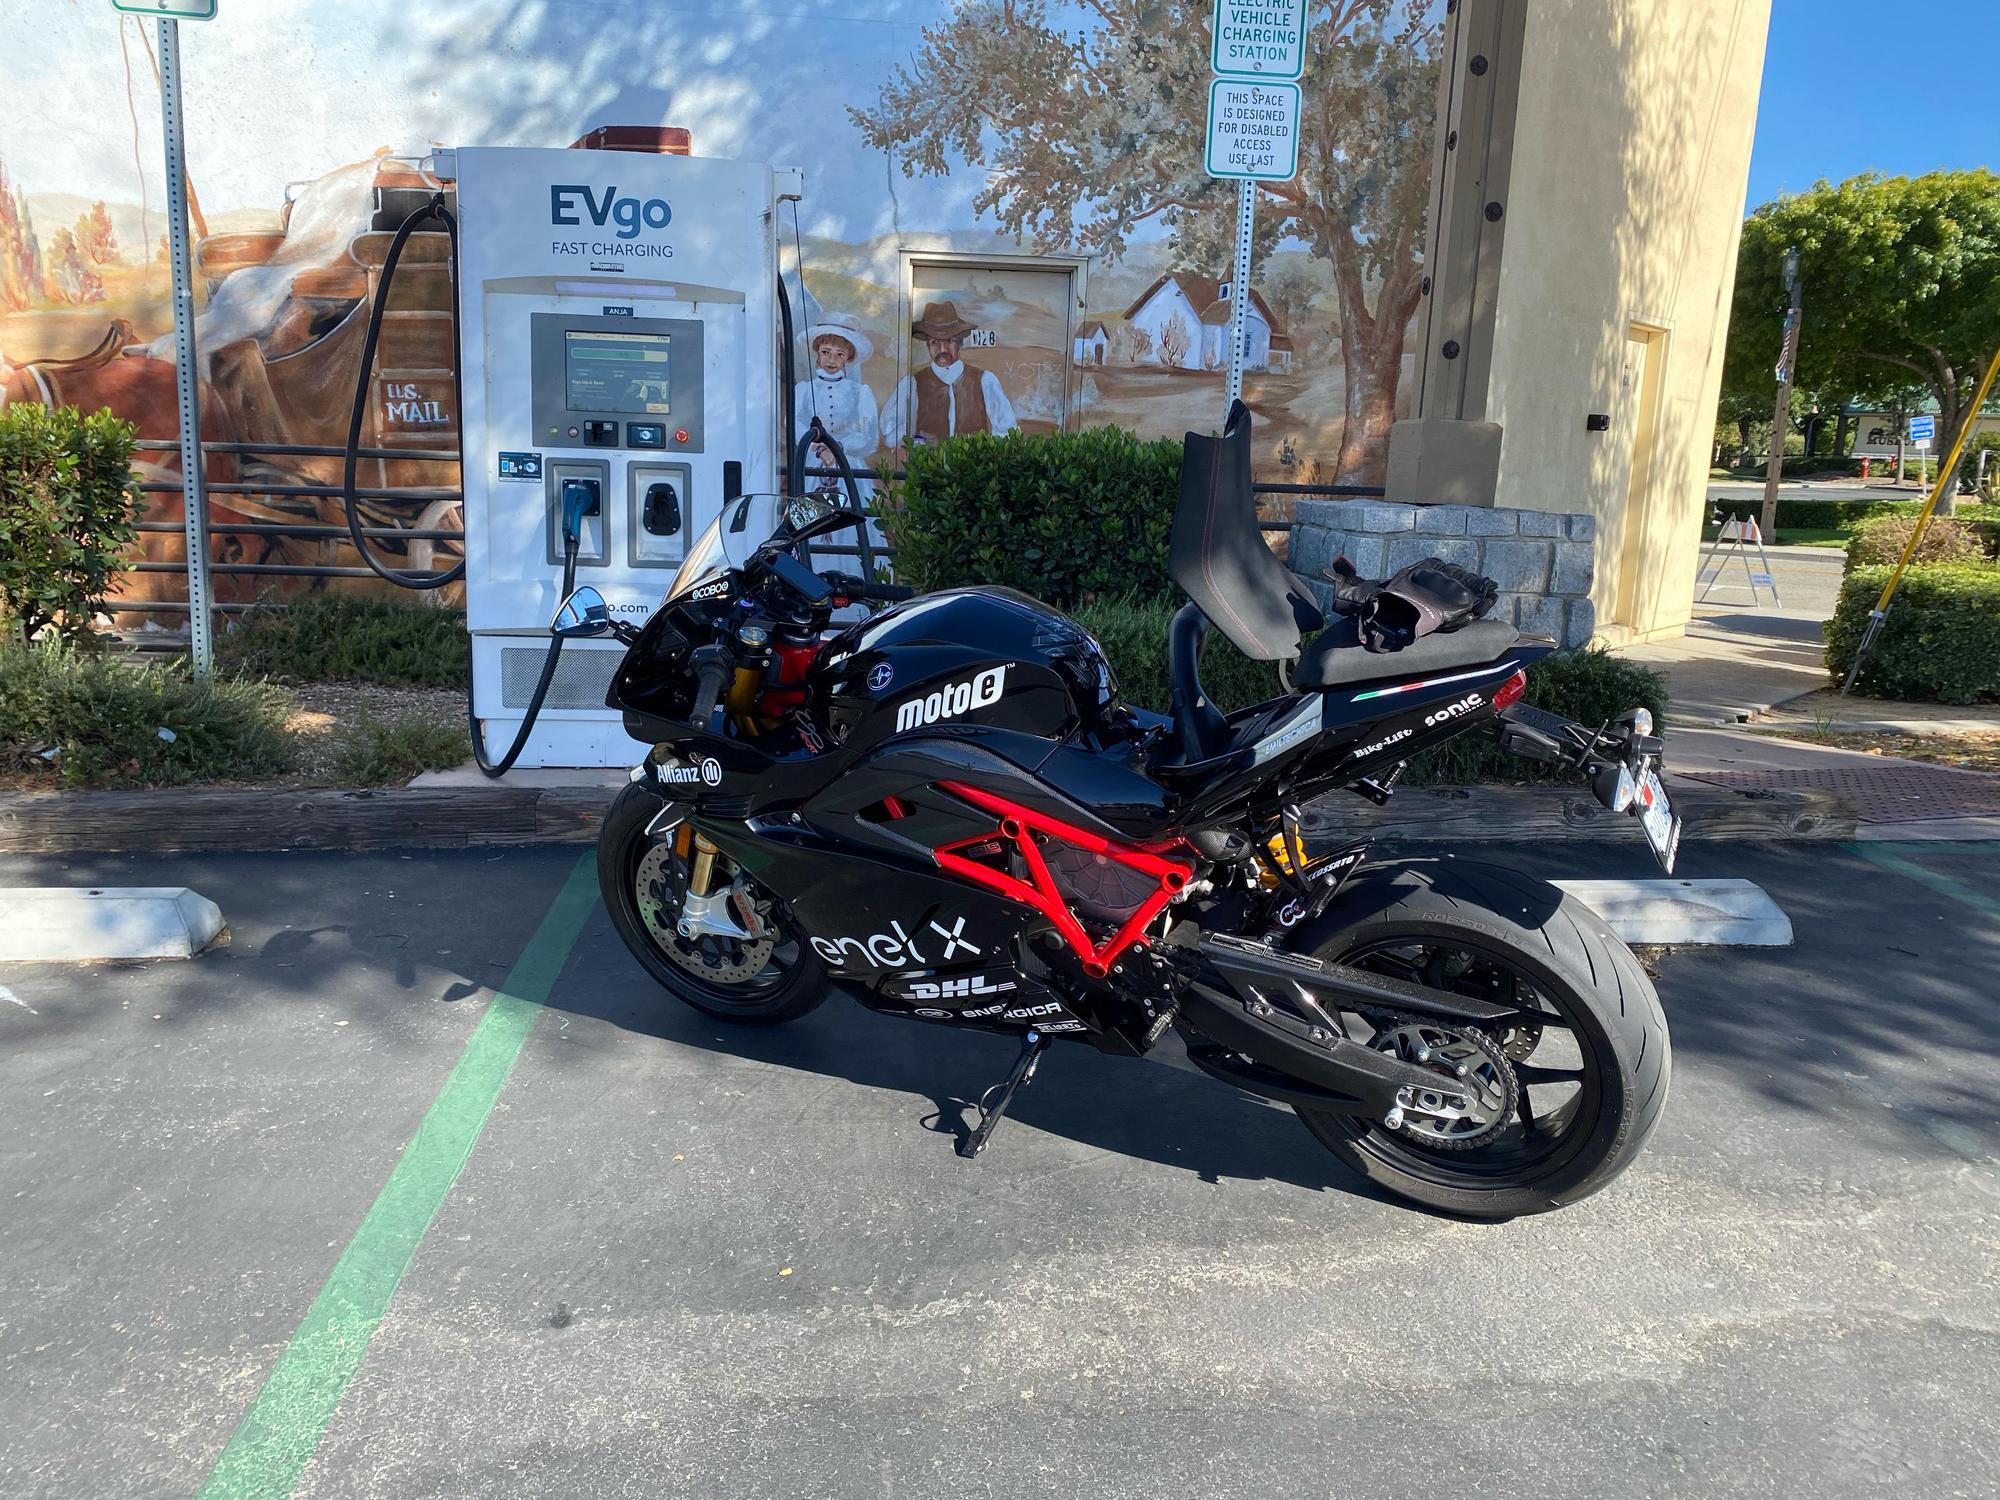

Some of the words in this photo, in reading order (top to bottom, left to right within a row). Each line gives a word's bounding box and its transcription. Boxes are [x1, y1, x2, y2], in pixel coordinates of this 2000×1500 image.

[1231, 10, 1291, 27] VEHICLE
[1223, 27, 1296, 44] CHARGING
[1229, 45, 1287, 61] STATION
[1227, 92, 1249, 104] THIS
[1252, 93, 1284, 106] SPACE
[1223, 108, 1233, 118] IS
[1236, 108, 1285, 122] DESIGNED
[1218, 122, 1237, 134] FOR
[1241, 123, 1288, 137] DISABLED
[1233, 138, 1271, 150] ACCESS
[1228, 154, 1247, 164] USE
[1251, 154, 1275, 166] LAST
[551, 185, 672, 239] EVgo
[552, 242, 588, 255] FAST
[592, 243, 673, 258] CHARGING
[385, 402, 449, 423] MAIL
[607, 604, 648, 613] o.com
[1353, 729, 1413, 758] Bike-Lift
[657, 764, 700, 783] Allianz
[1307, 855, 1355, 881] CCOSSATO
[810, 920, 926, 968] enel
[929, 916, 981, 960] X
[909, 975, 998, 999] DHL
